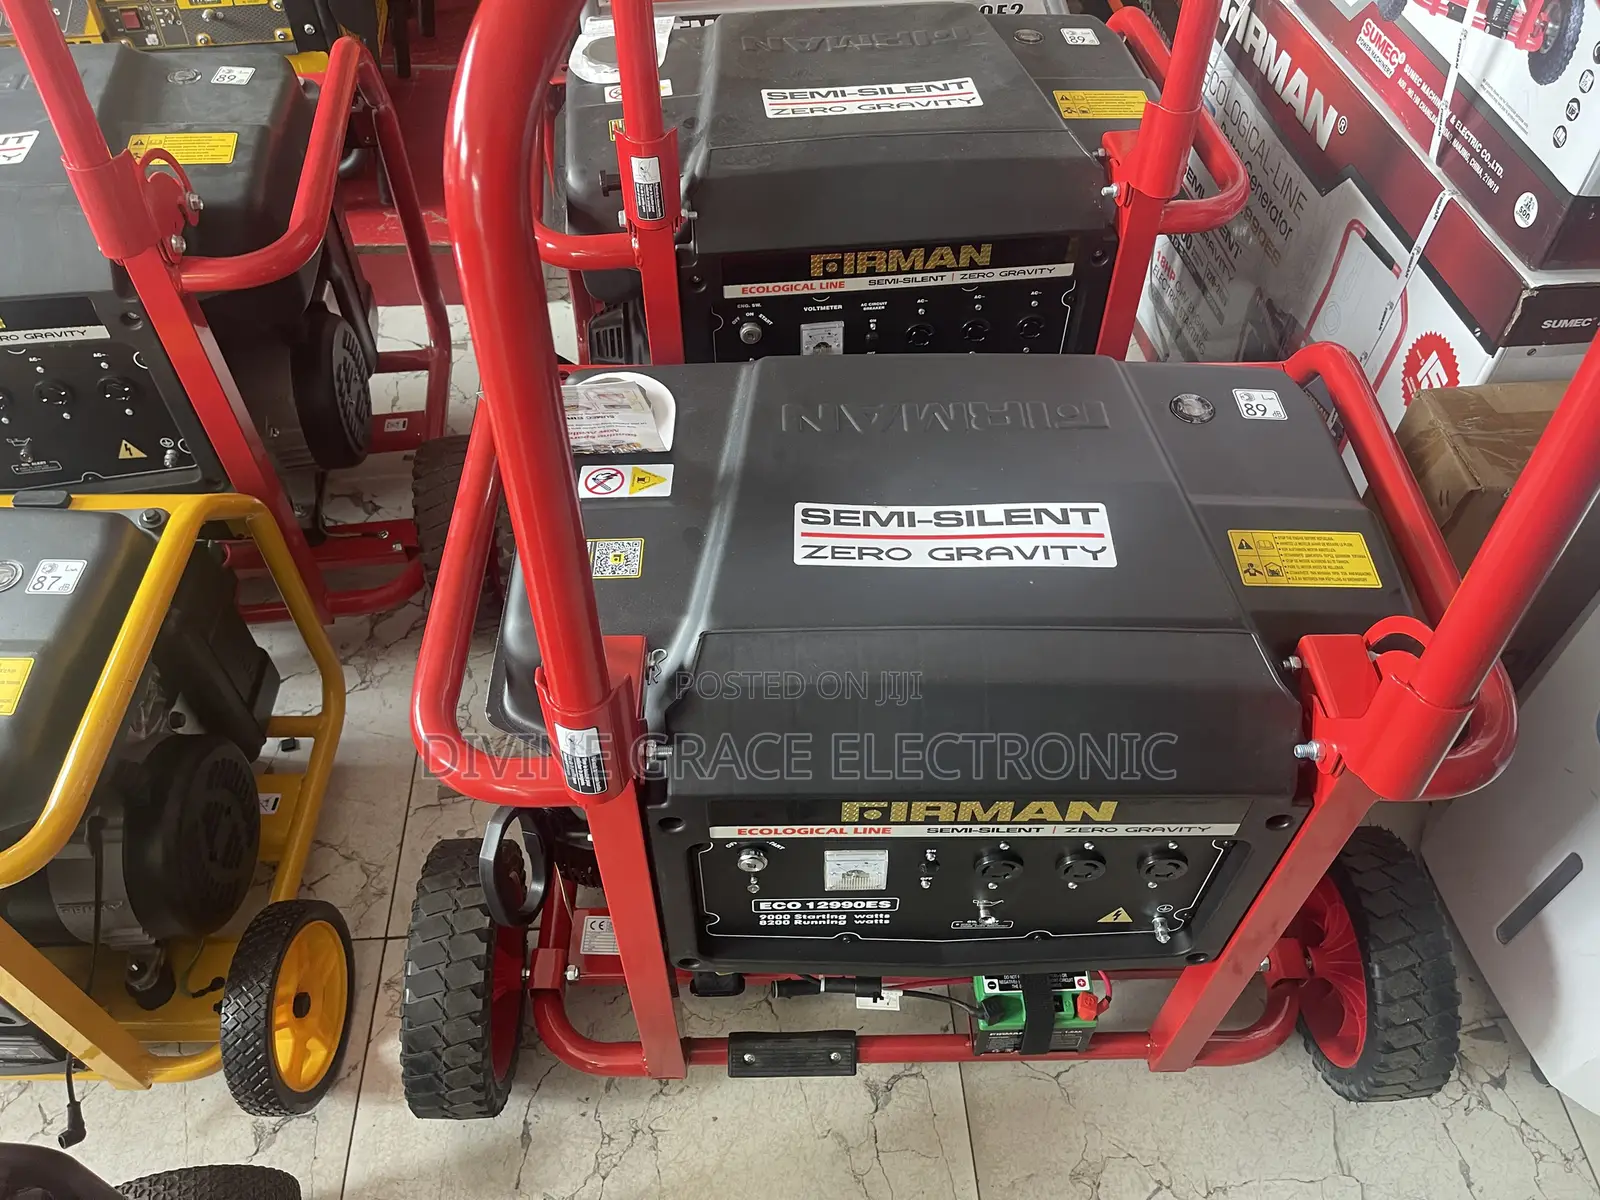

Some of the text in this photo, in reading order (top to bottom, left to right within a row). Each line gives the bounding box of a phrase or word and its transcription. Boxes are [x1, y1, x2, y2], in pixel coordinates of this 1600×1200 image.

[1069, 36, 1086, 44] 89
[1363, 21, 1399, 67] SUMEC
[216, 75, 237, 83] 89
[766, 80, 969, 101] SEMI-SILENT
[772, 97, 977, 116] ZERO GRAVITY
[1403, 63, 1423, 87] SUMEC
[1449, 115, 1457, 125] &
[1455, 120, 1482, 153] ELECTRIC
[811, 243, 993, 278] FIRMAN
[741, 267, 1056, 295] ECOLOGICAL LINE SEMI-SILENT ZERO GRAVITY
[803, 304, 843, 312] VOLTMETER
[758, 313, 774, 326] START
[1541, 317, 1593, 329] SUMEC
[24, 329, 87, 340] GRAVITY
[781, 400, 1111, 433] FIRMAN
[1243, 402, 1283, 418] 89 dB
[800, 507, 1100, 528] SEMI-SILENT
[801, 544, 1108, 561] ZERO GRAVITY
[32, 575, 62, 591] 87
[841, 801, 1119, 822] FIRMAN
[737, 827, 850, 836] ECOLOGICAL
[853, 827, 893, 836] LINE
[1064, 826, 1118, 834] ZERO
[1125, 826, 1214, 834] GRAVITY
[759, 901, 892, 910] ECO 12990ES
[794, 913, 847, 921] Starting
